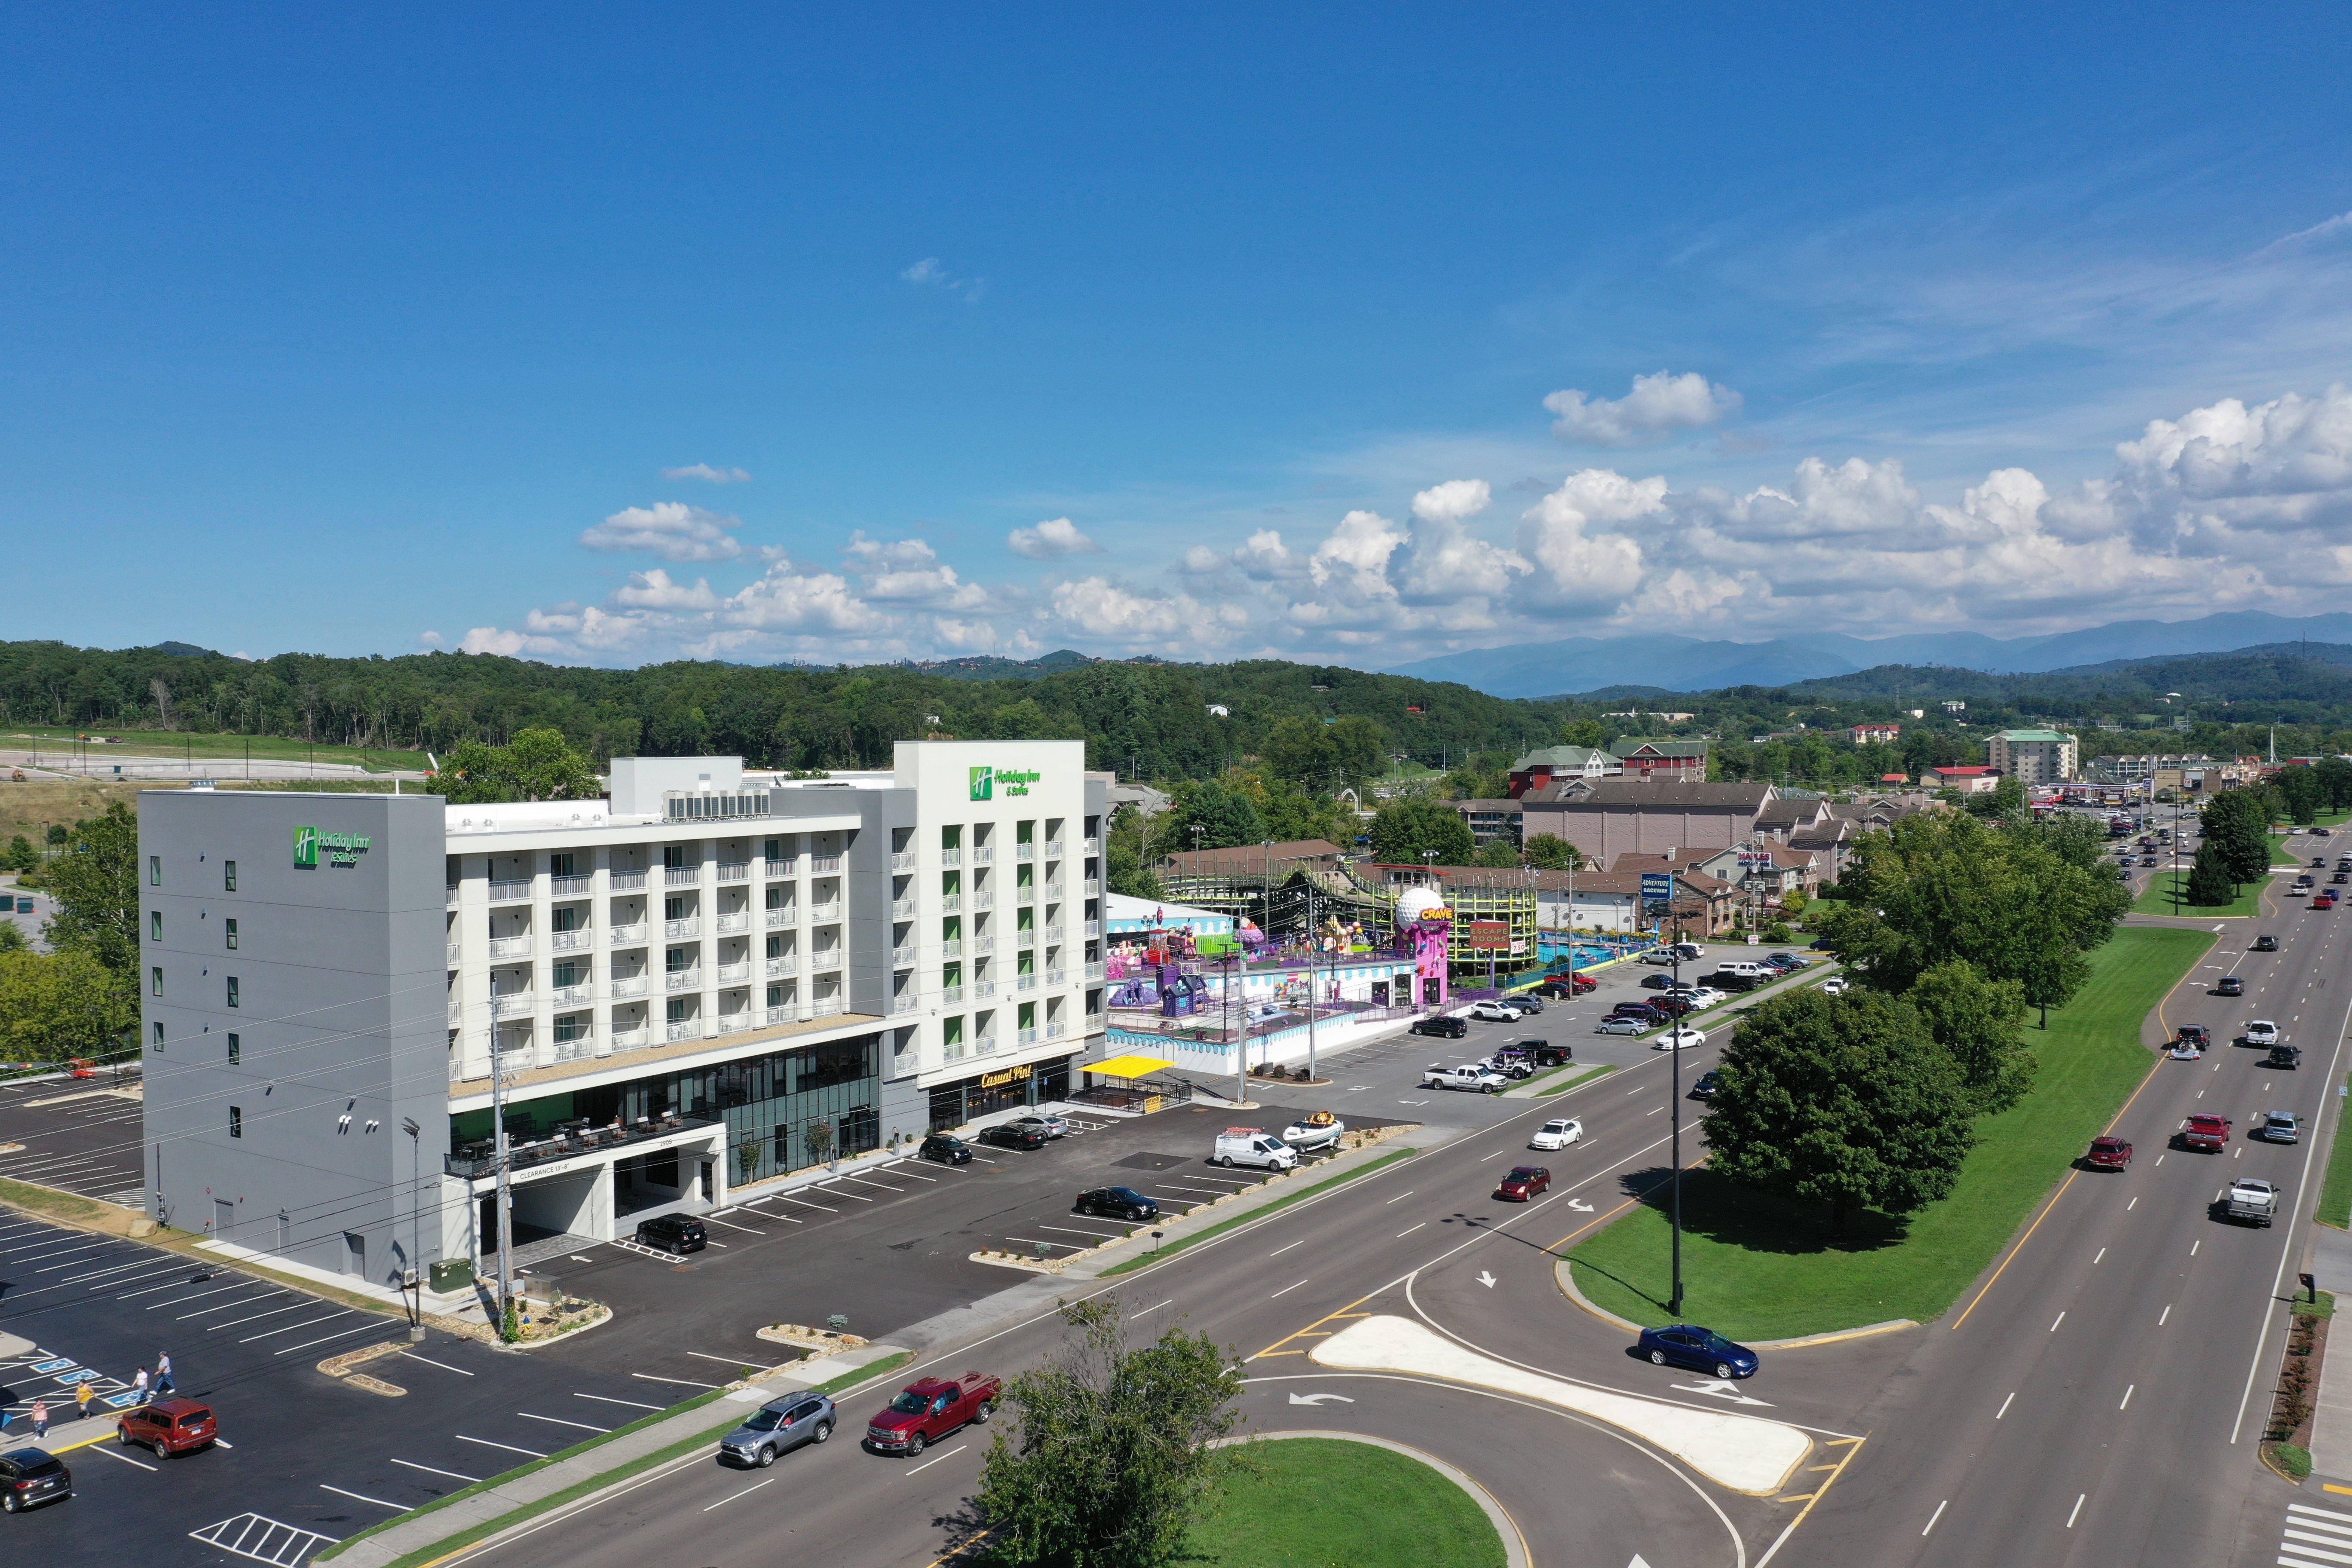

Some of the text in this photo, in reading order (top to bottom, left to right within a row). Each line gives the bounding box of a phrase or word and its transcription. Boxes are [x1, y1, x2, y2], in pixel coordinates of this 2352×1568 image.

[994, 769, 1040, 786] Holiday Inn
[1012, 786, 1029, 795] Suites
[318, 831, 369, 851] Holiday Inn
[337, 851, 358, 863] Suites
[1422, 909, 1452, 919] CRAVE
[981, 1065, 1031, 1088] Casual Pint
[520, 1167, 554, 1179] CLEARANCE
